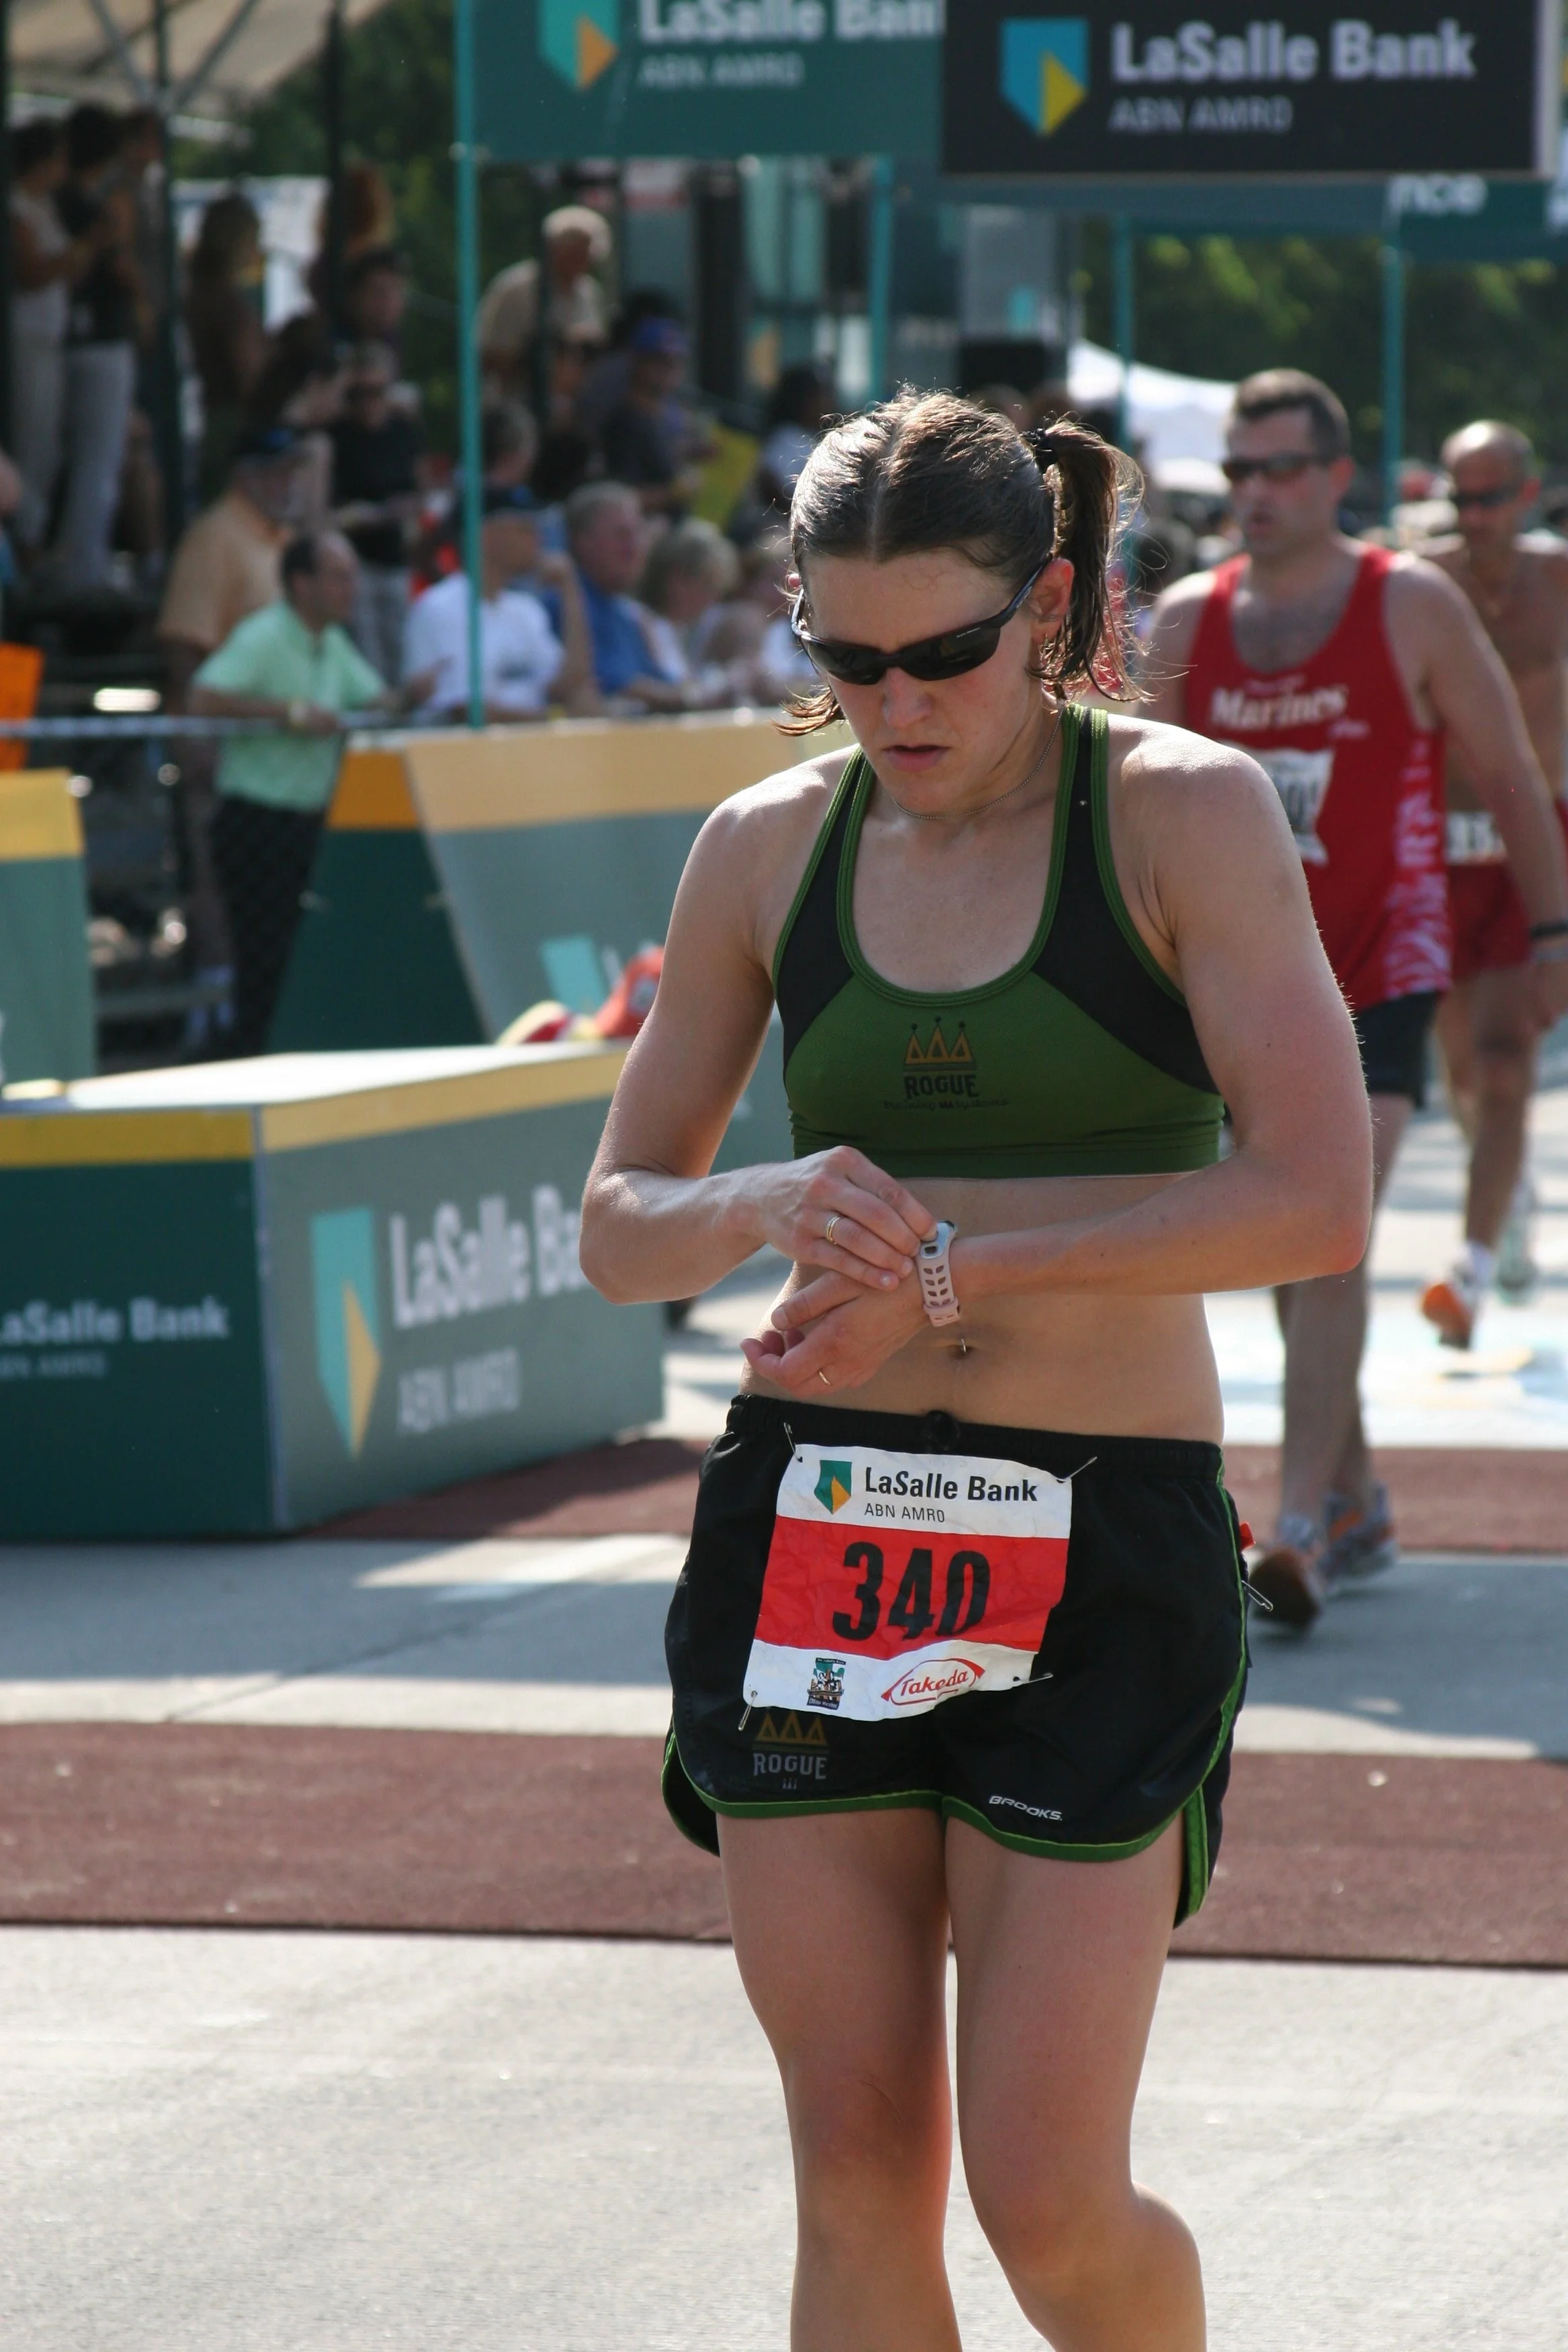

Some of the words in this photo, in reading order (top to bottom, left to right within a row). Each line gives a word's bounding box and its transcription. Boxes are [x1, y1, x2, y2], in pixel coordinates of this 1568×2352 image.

[638, 0, 823, 42] LaSalle
[1112, 21, 1318, 82] LaSalle
[1330, 19, 1474, 79] Bank
[1110, 98, 1183, 130] ABN
[1192, 97, 1293, 132] AMRO
[904, 1075, 979, 1099] ROGUE
[389, 1202, 530, 1330] LaSalle
[534, 1184, 588, 1297] Ba
[0, 1301, 121, 1343] aSalle
[130, 1296, 230, 1342] Bank
[865, 1467, 959, 1500] LaSalle
[967, 1475, 1038, 1502] Bank
[864, 1502, 895, 1518] ABN
[901, 1506, 945, 1523] AMRO
[832, 1542, 991, 1641] 340
[900, 1669, 969, 1697] Takeda
[752, 1753, 828, 1780] ROGUE
